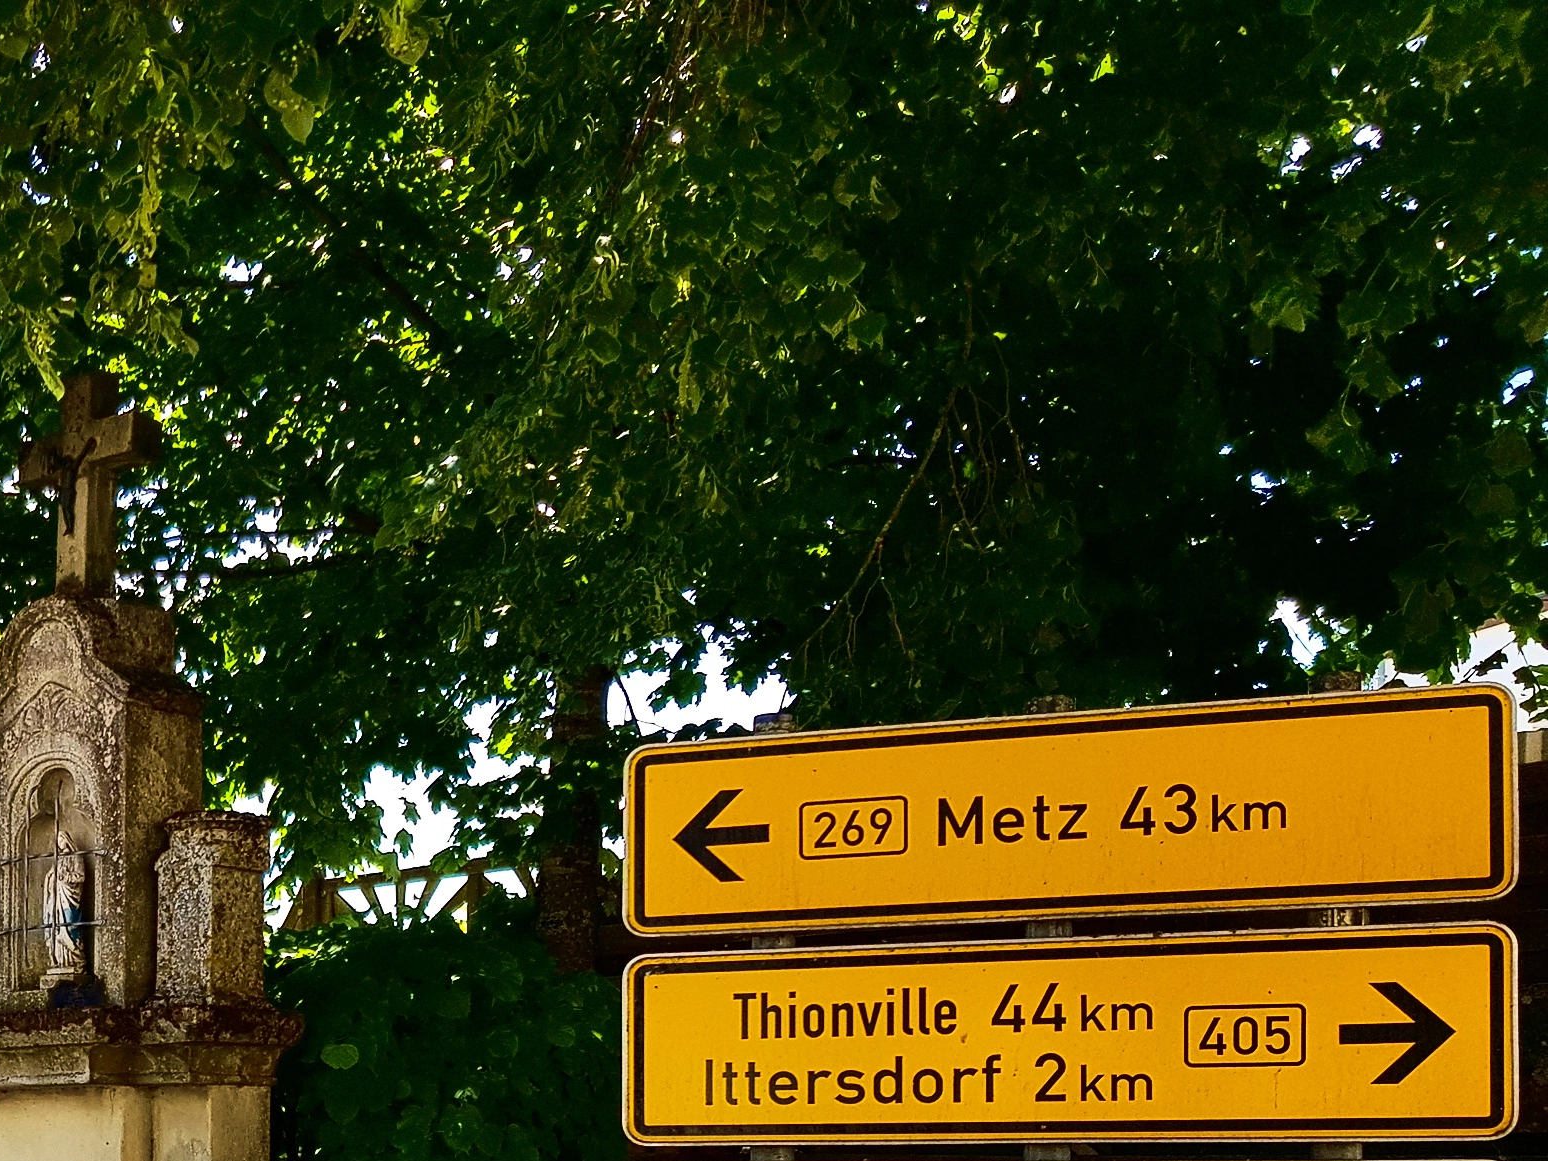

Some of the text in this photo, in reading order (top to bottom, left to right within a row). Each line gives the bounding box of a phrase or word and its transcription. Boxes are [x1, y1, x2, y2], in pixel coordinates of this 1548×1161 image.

[813, 807, 894, 849] 269
[937, 795, 1088, 847] Metz
[732, 992, 957, 1040] Thionville
[1198, 1015, 1291, 1056] 405
[705, 1053, 1002, 1106] Ittersdorf
